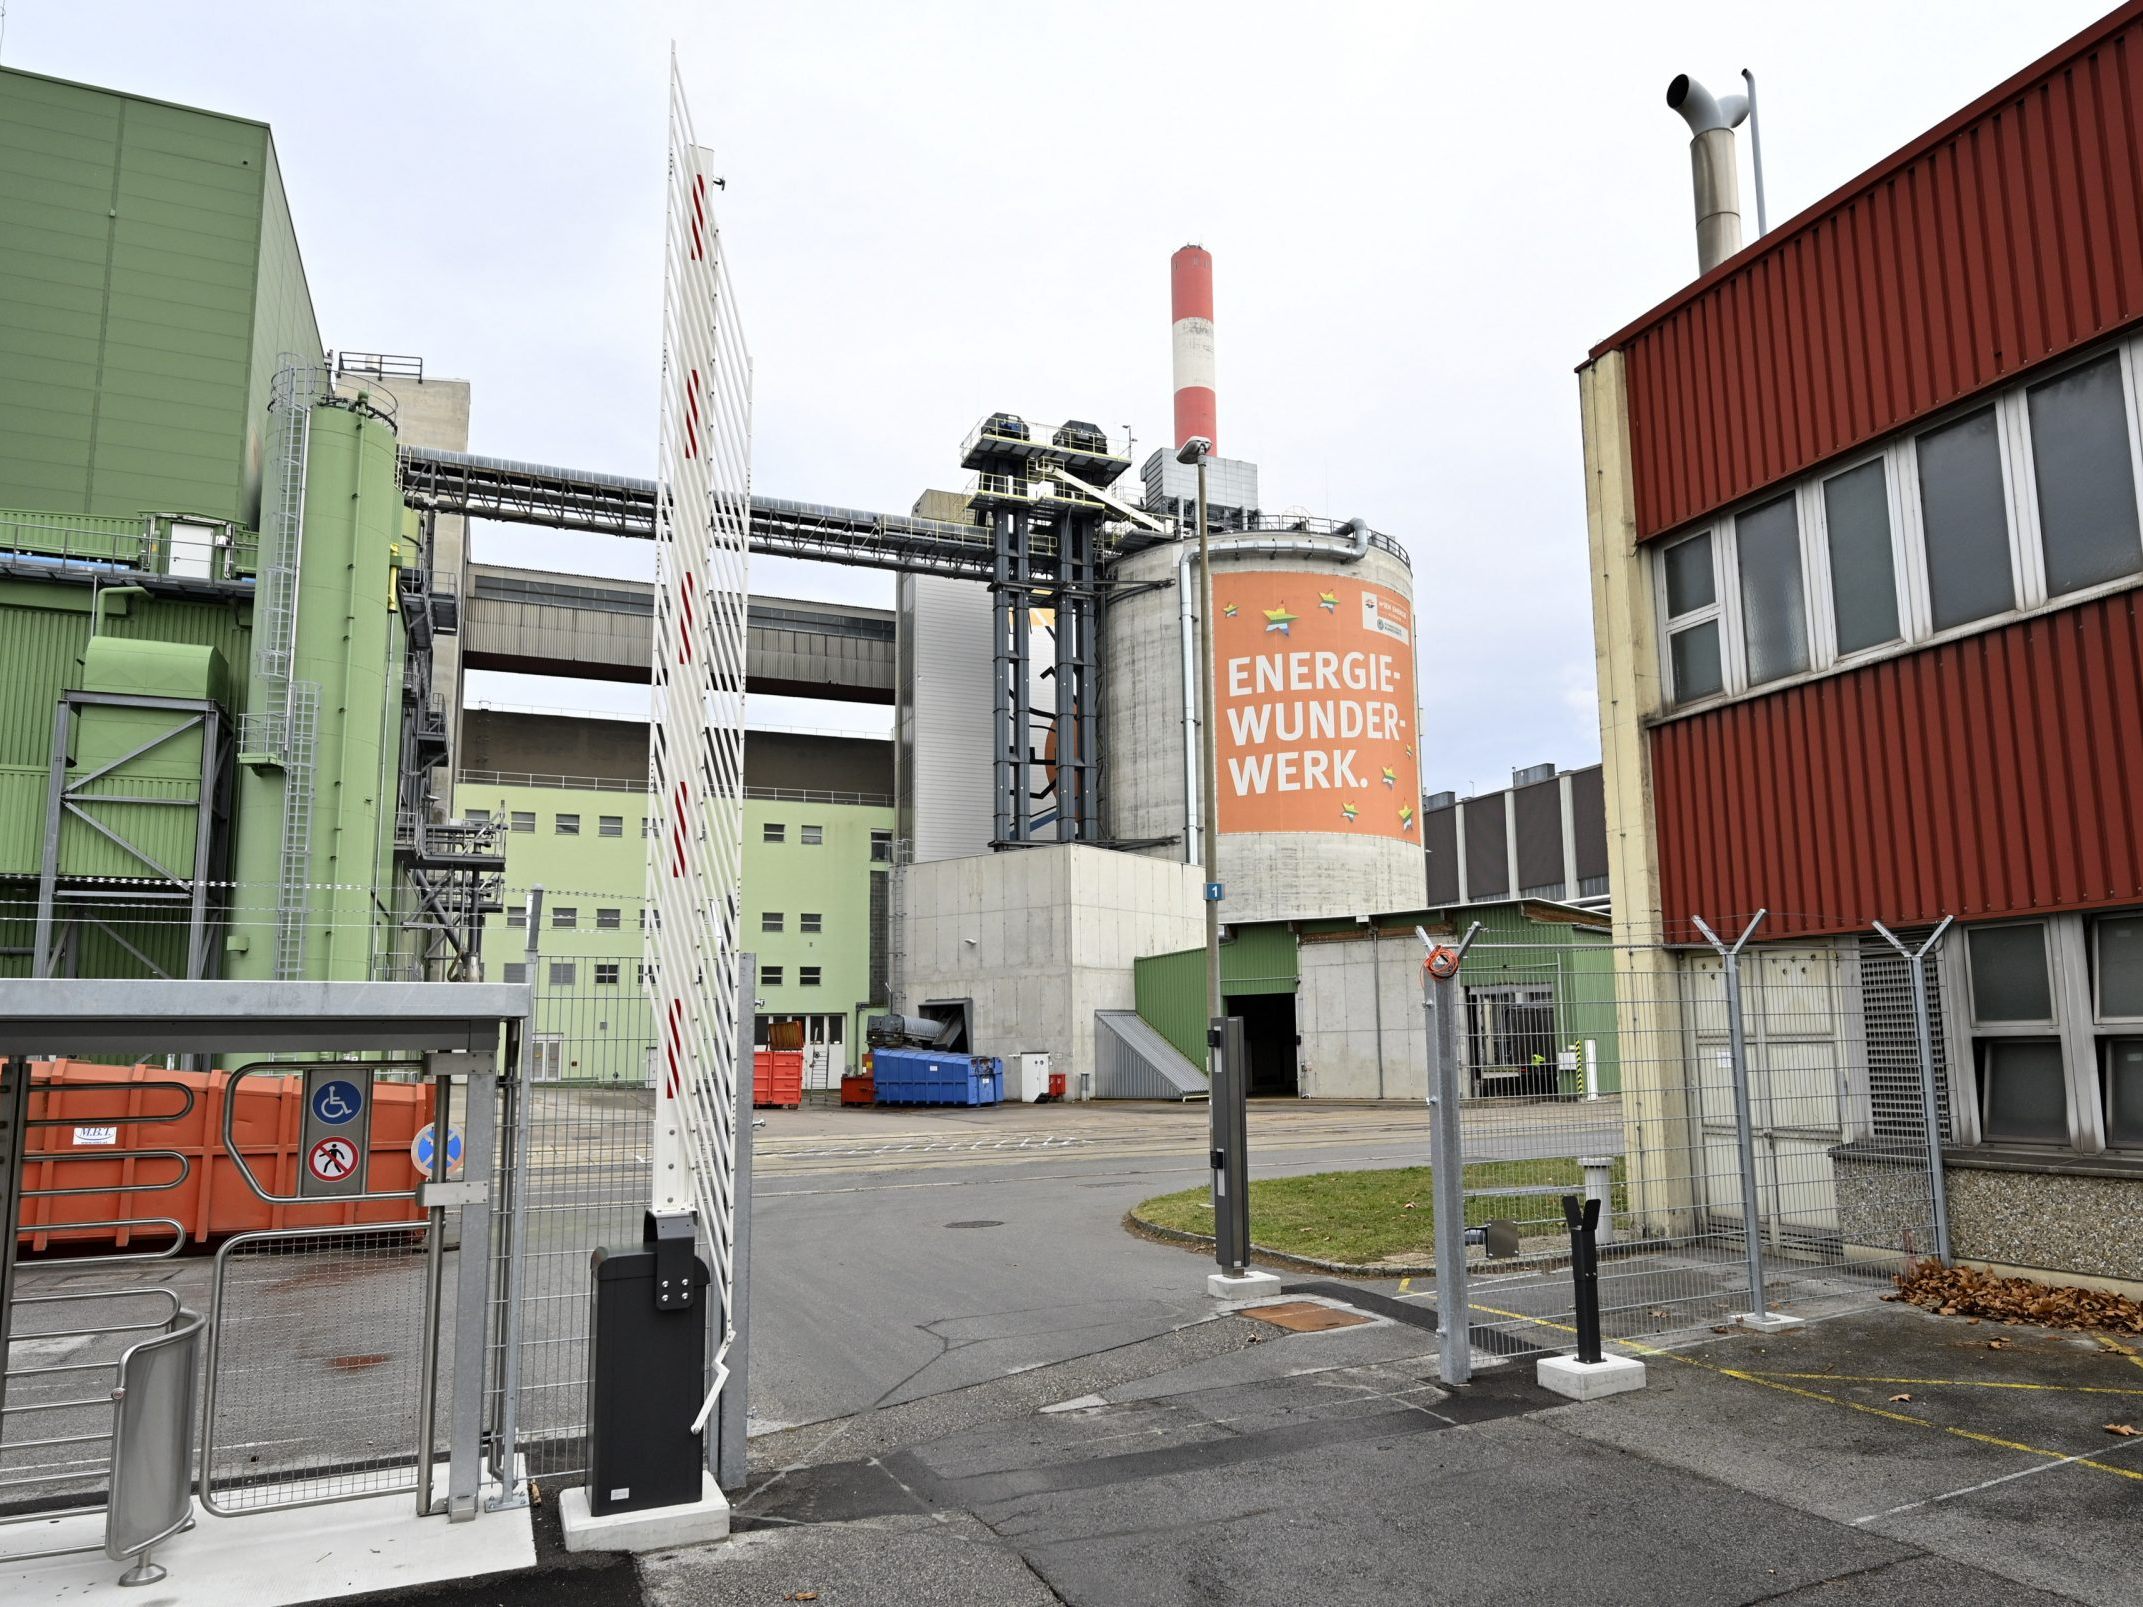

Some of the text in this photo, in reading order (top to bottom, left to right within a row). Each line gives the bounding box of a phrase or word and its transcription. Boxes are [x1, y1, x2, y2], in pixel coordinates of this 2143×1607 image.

[1227, 652, 1400, 697] ENERGIE-
[1226, 700, 1406, 746] WUNDER-
[1228, 750, 1368, 797] WERK.
[1211, 885, 1218, 898] 1
